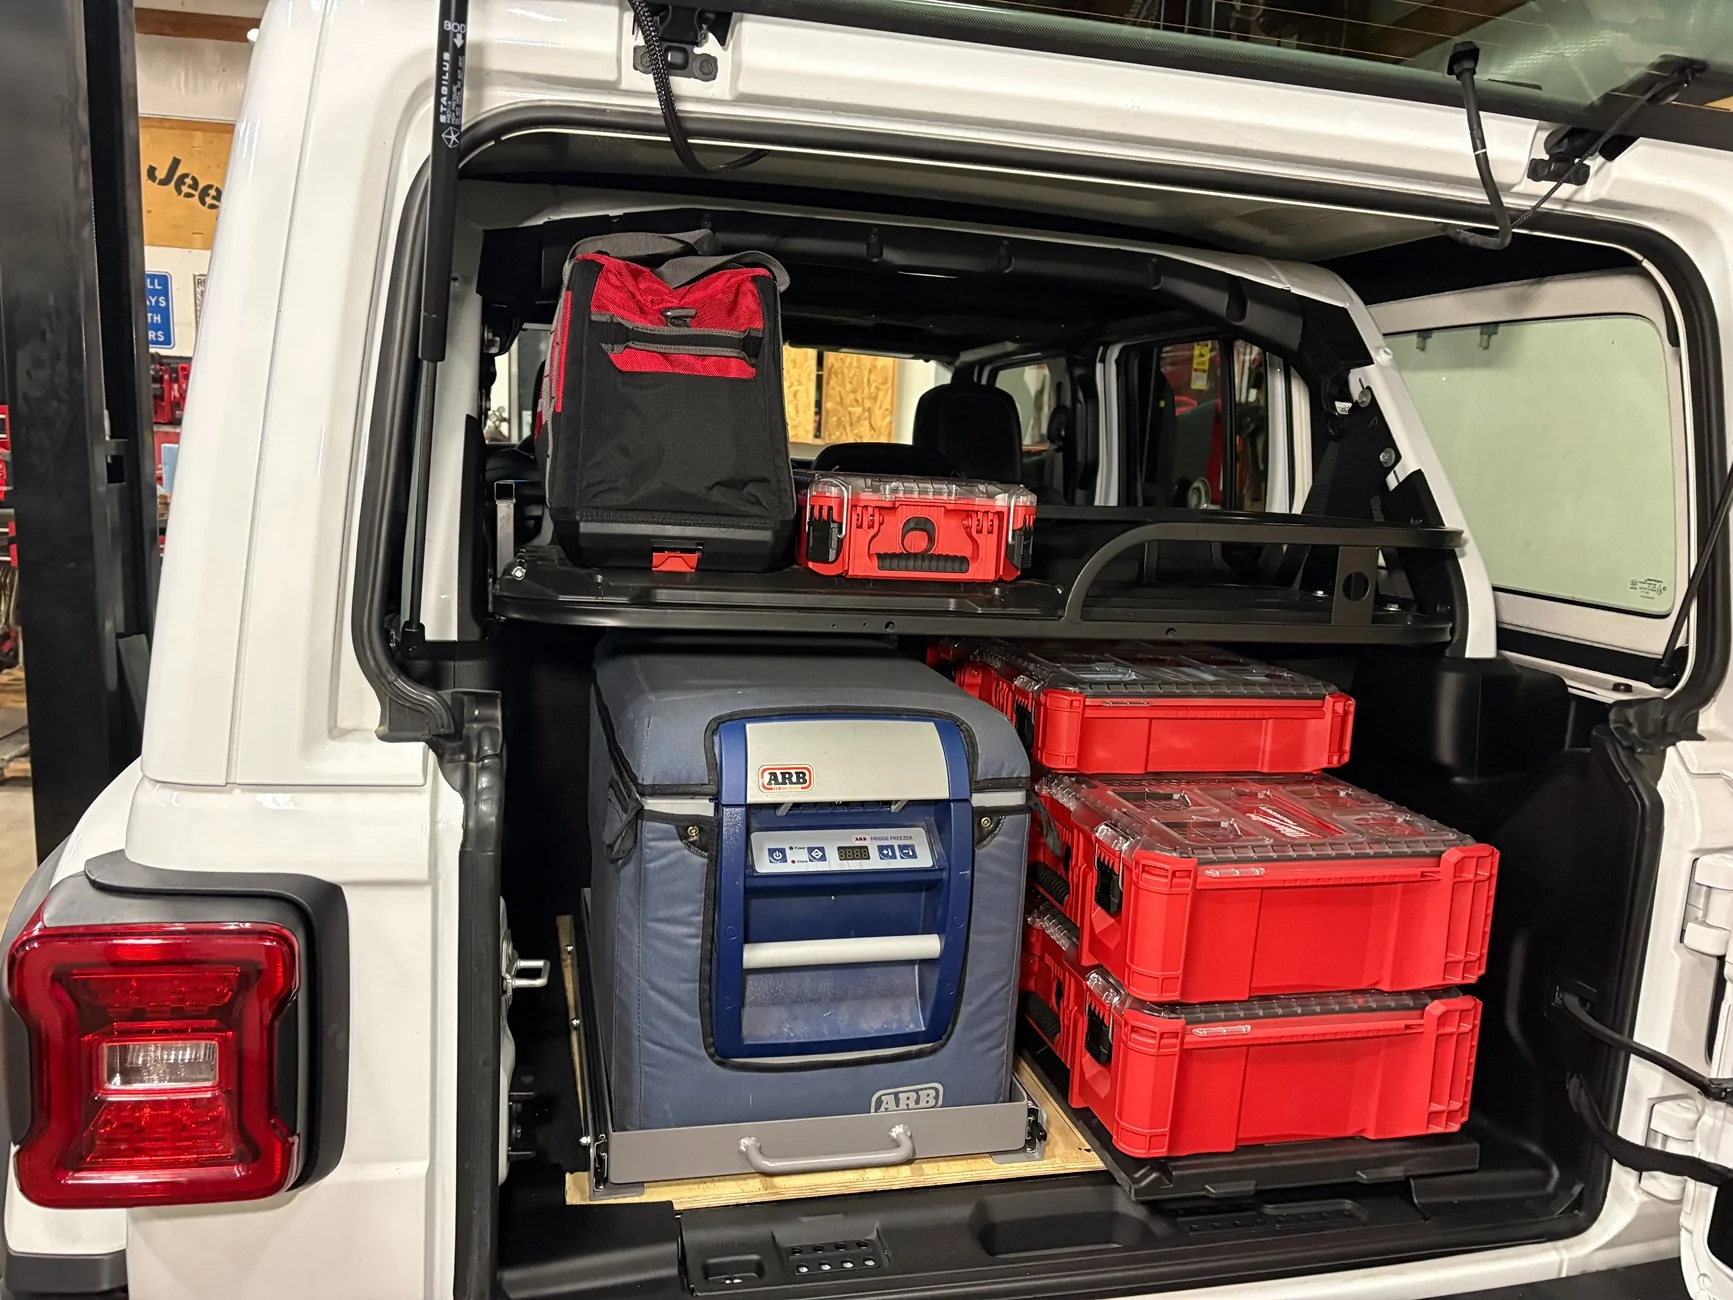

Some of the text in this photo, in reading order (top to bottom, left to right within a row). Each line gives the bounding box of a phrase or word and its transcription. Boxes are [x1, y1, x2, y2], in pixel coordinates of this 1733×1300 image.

[440, 51, 451, 124] STABILUS
[146, 155, 223, 211] Jee
[766, 770, 808, 786] ARB
[877, 1088, 937, 1113] ARB
